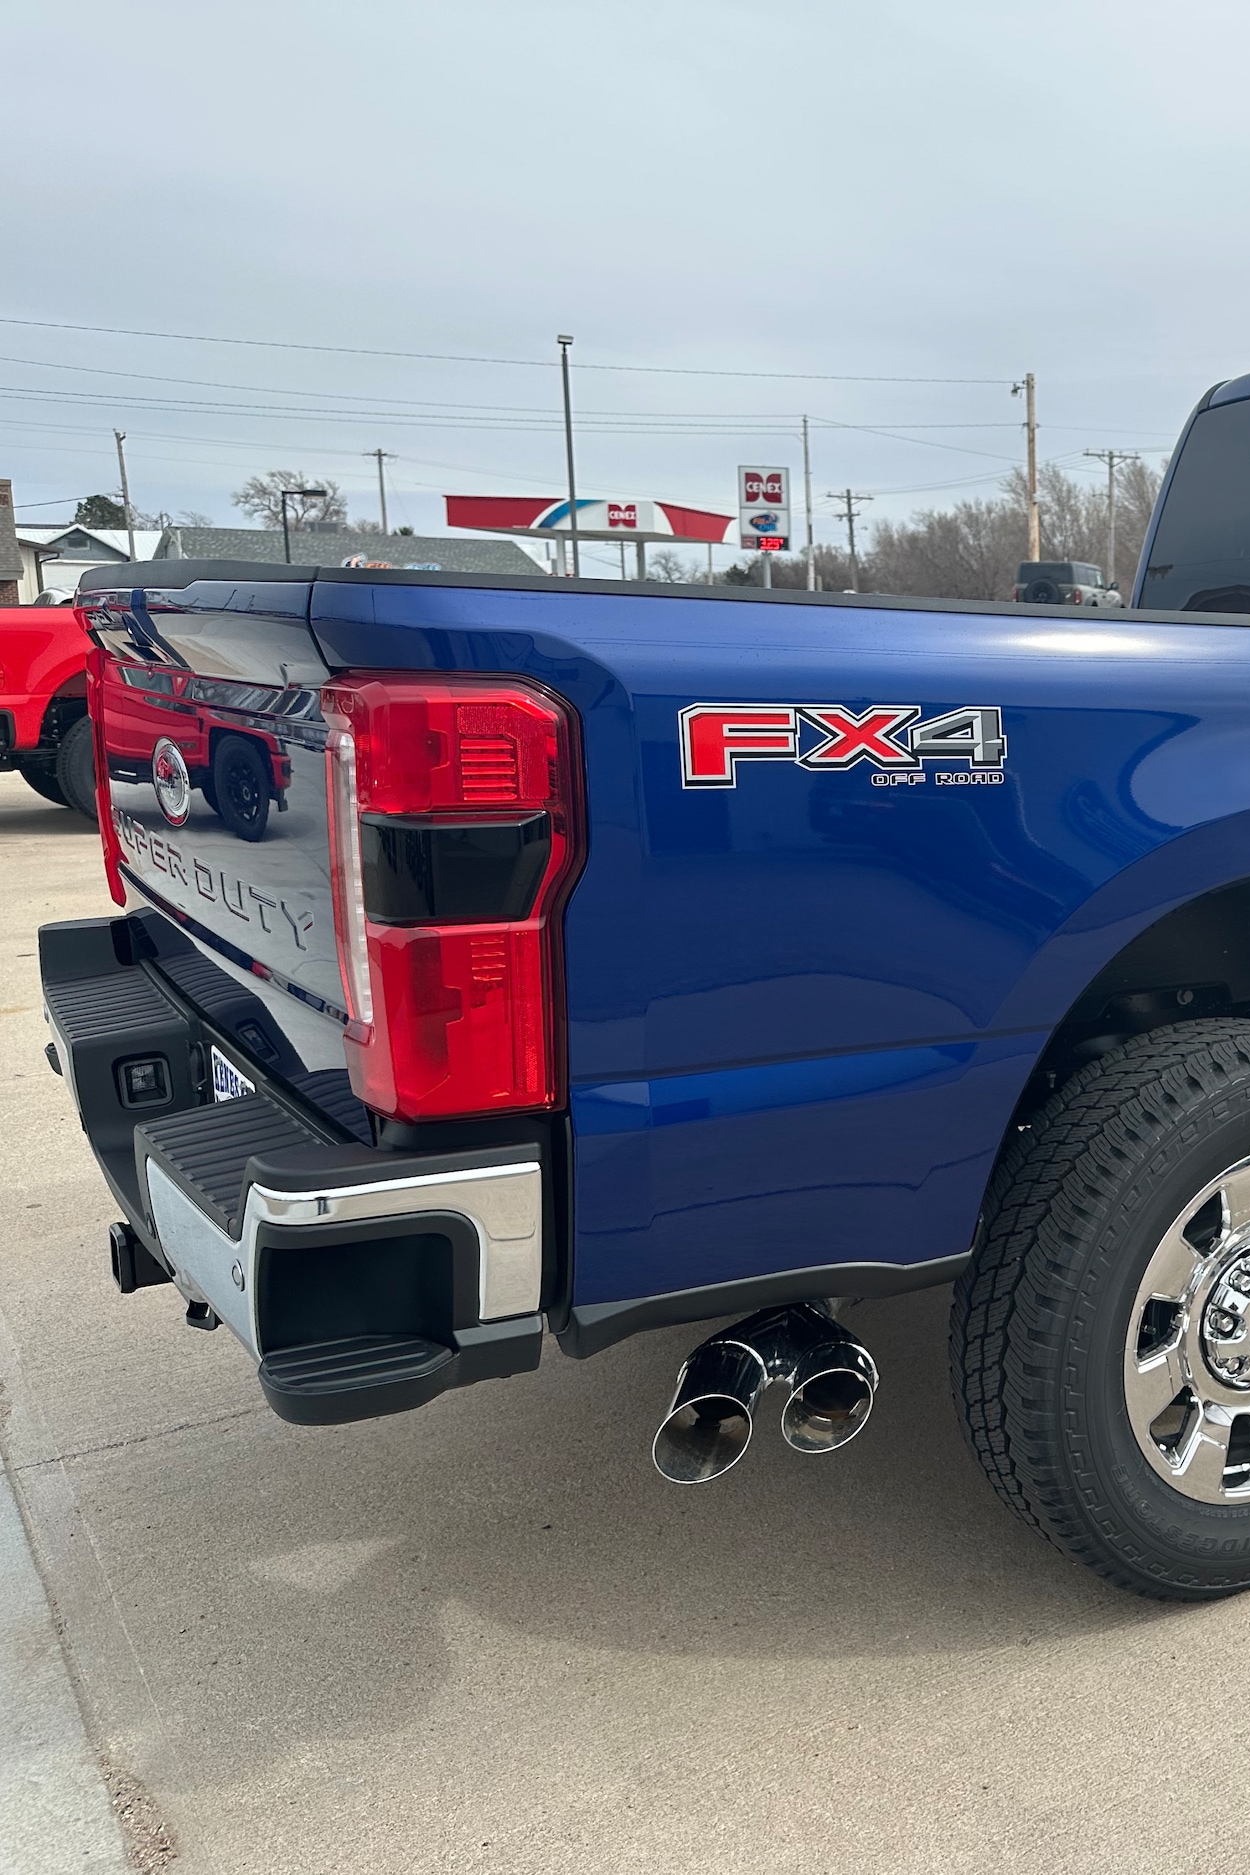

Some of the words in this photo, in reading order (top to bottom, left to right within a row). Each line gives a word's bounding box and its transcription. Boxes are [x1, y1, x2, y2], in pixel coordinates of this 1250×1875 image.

[746, 481, 782, 493] CENEX
[609, 510, 637, 520] CENEX
[678, 702, 1007, 790] FX4
[871, 772, 927, 787] OFF
[935, 771, 1005, 786] ROAD
[193, 856, 315, 952] DUTY
